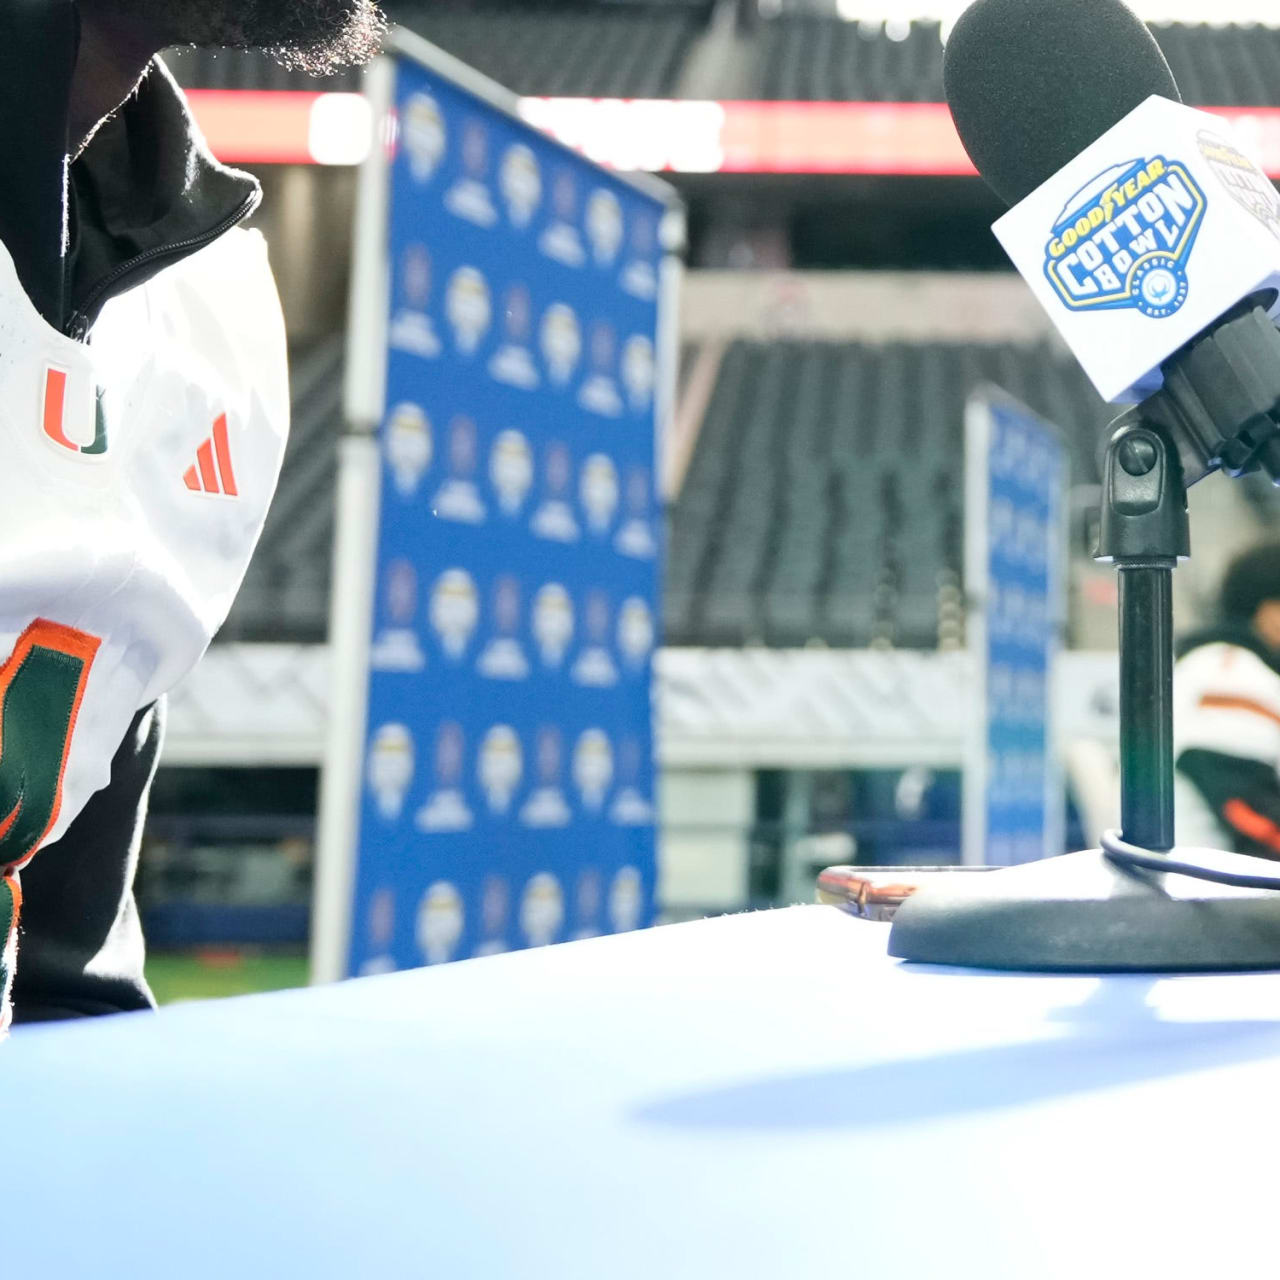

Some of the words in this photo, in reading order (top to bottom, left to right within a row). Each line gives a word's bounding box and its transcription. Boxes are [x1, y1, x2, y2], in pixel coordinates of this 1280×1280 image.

[1049, 158, 1167, 258] GOODYEAR
[1056, 172, 1193, 296] COTTON
[1093, 218, 1179, 291] BOWL
[1132, 258, 1175, 296] CLASSIC
